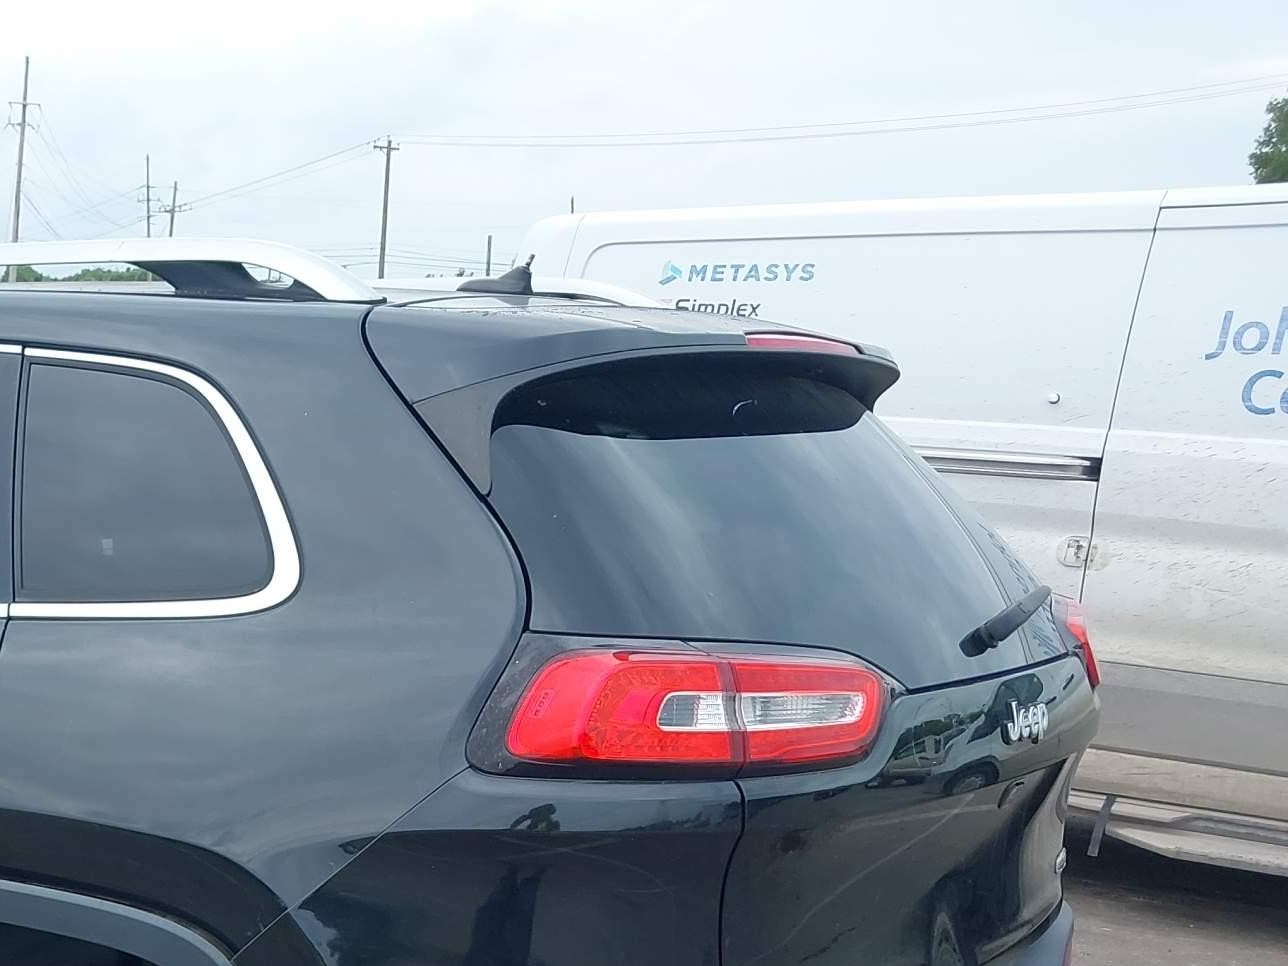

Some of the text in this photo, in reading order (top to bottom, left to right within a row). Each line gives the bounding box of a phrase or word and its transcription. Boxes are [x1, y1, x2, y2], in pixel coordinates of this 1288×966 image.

[687, 263, 816, 282] METASYS
[1241, 369, 1288, 415] C
[1007, 700, 1049, 741] Jeep
